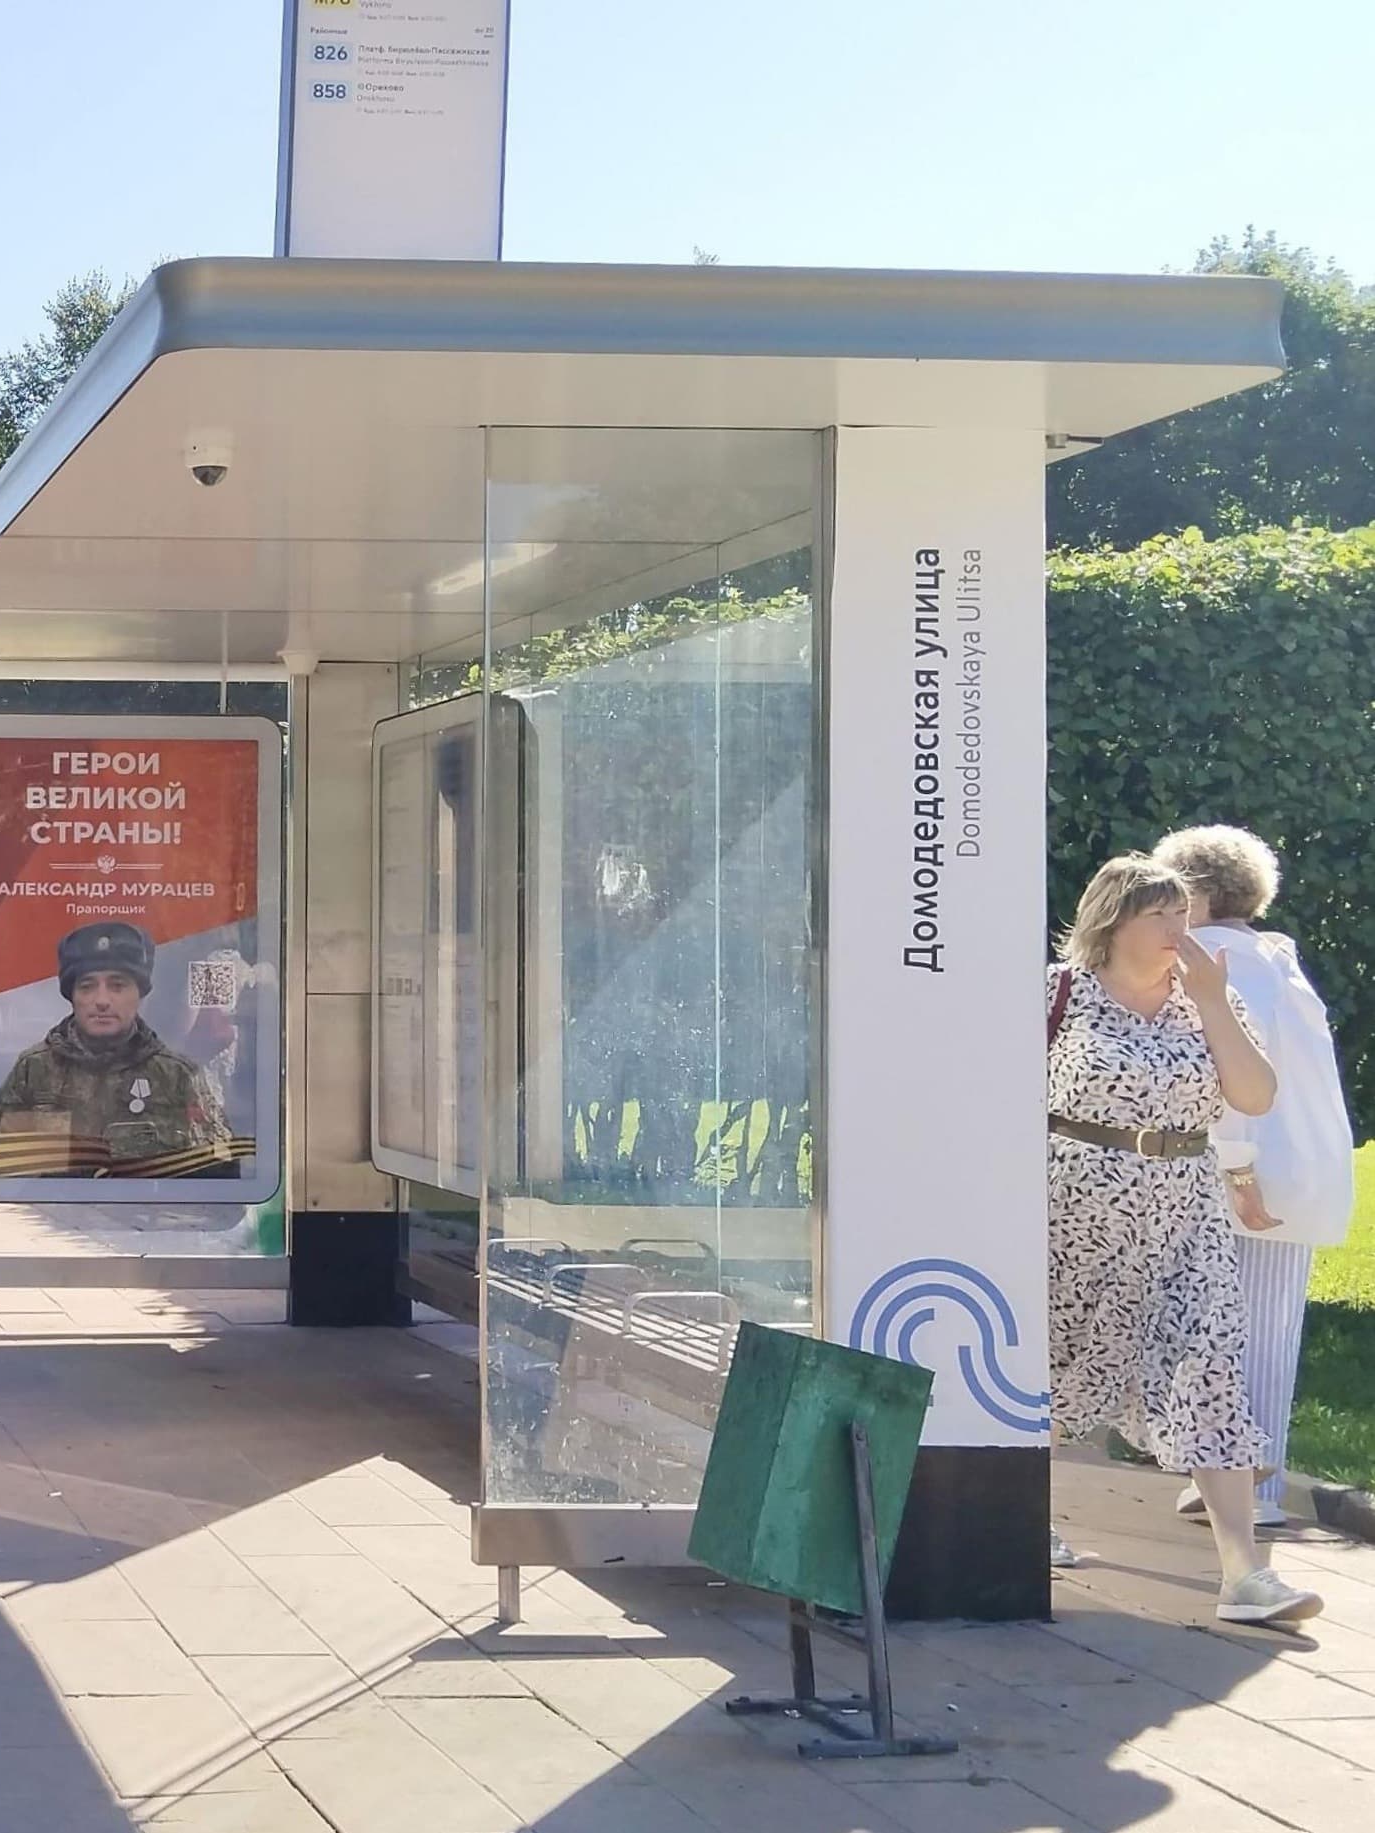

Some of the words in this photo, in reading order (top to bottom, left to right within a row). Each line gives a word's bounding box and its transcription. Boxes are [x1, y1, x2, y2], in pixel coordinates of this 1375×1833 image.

[314, 45, 348, 61] 826
[313, 83, 347, 99] 858
[956, 549, 982, 623] Ulitsa
[914, 547, 948, 659] улица
[955, 631, 987, 858] Domodedovskaya
[52, 751, 160, 775] ГЕРОИ
[26, 781, 186, 810] ВЕЛИКОЙ
[30, 820, 181, 846] СТРАНЫ!
[903, 669, 944, 973] Домодедовская
[122, 882, 215, 900] МУРАЦЕВ
[66, 904, 146, 917] Прапорщик
